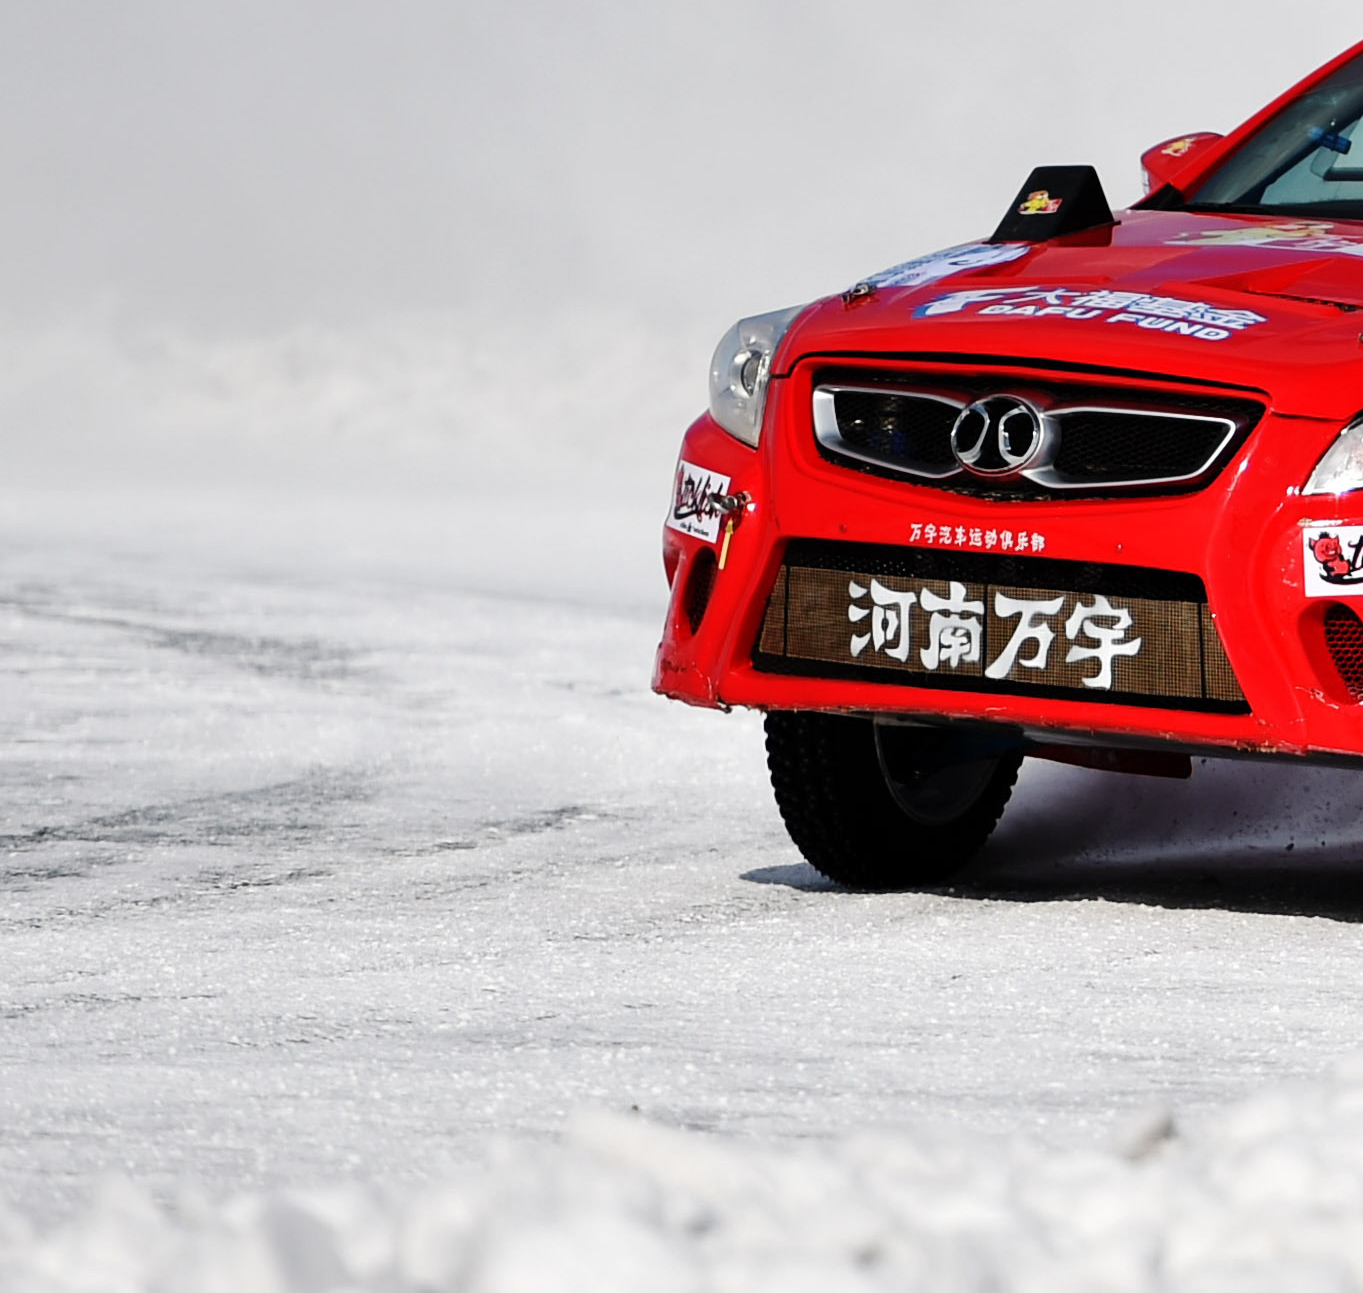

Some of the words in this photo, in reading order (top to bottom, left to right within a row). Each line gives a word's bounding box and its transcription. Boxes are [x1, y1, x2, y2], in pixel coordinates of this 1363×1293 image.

[976, 304, 1104, 319] DAFU
[1105, 311, 1233, 341] FUND
[1002, 287, 1268, 329] 大福基金
[909, 523, 1045, 553] 万宇汽车运动俱乐部
[848, 578, 1142, 690] 河南万宇
